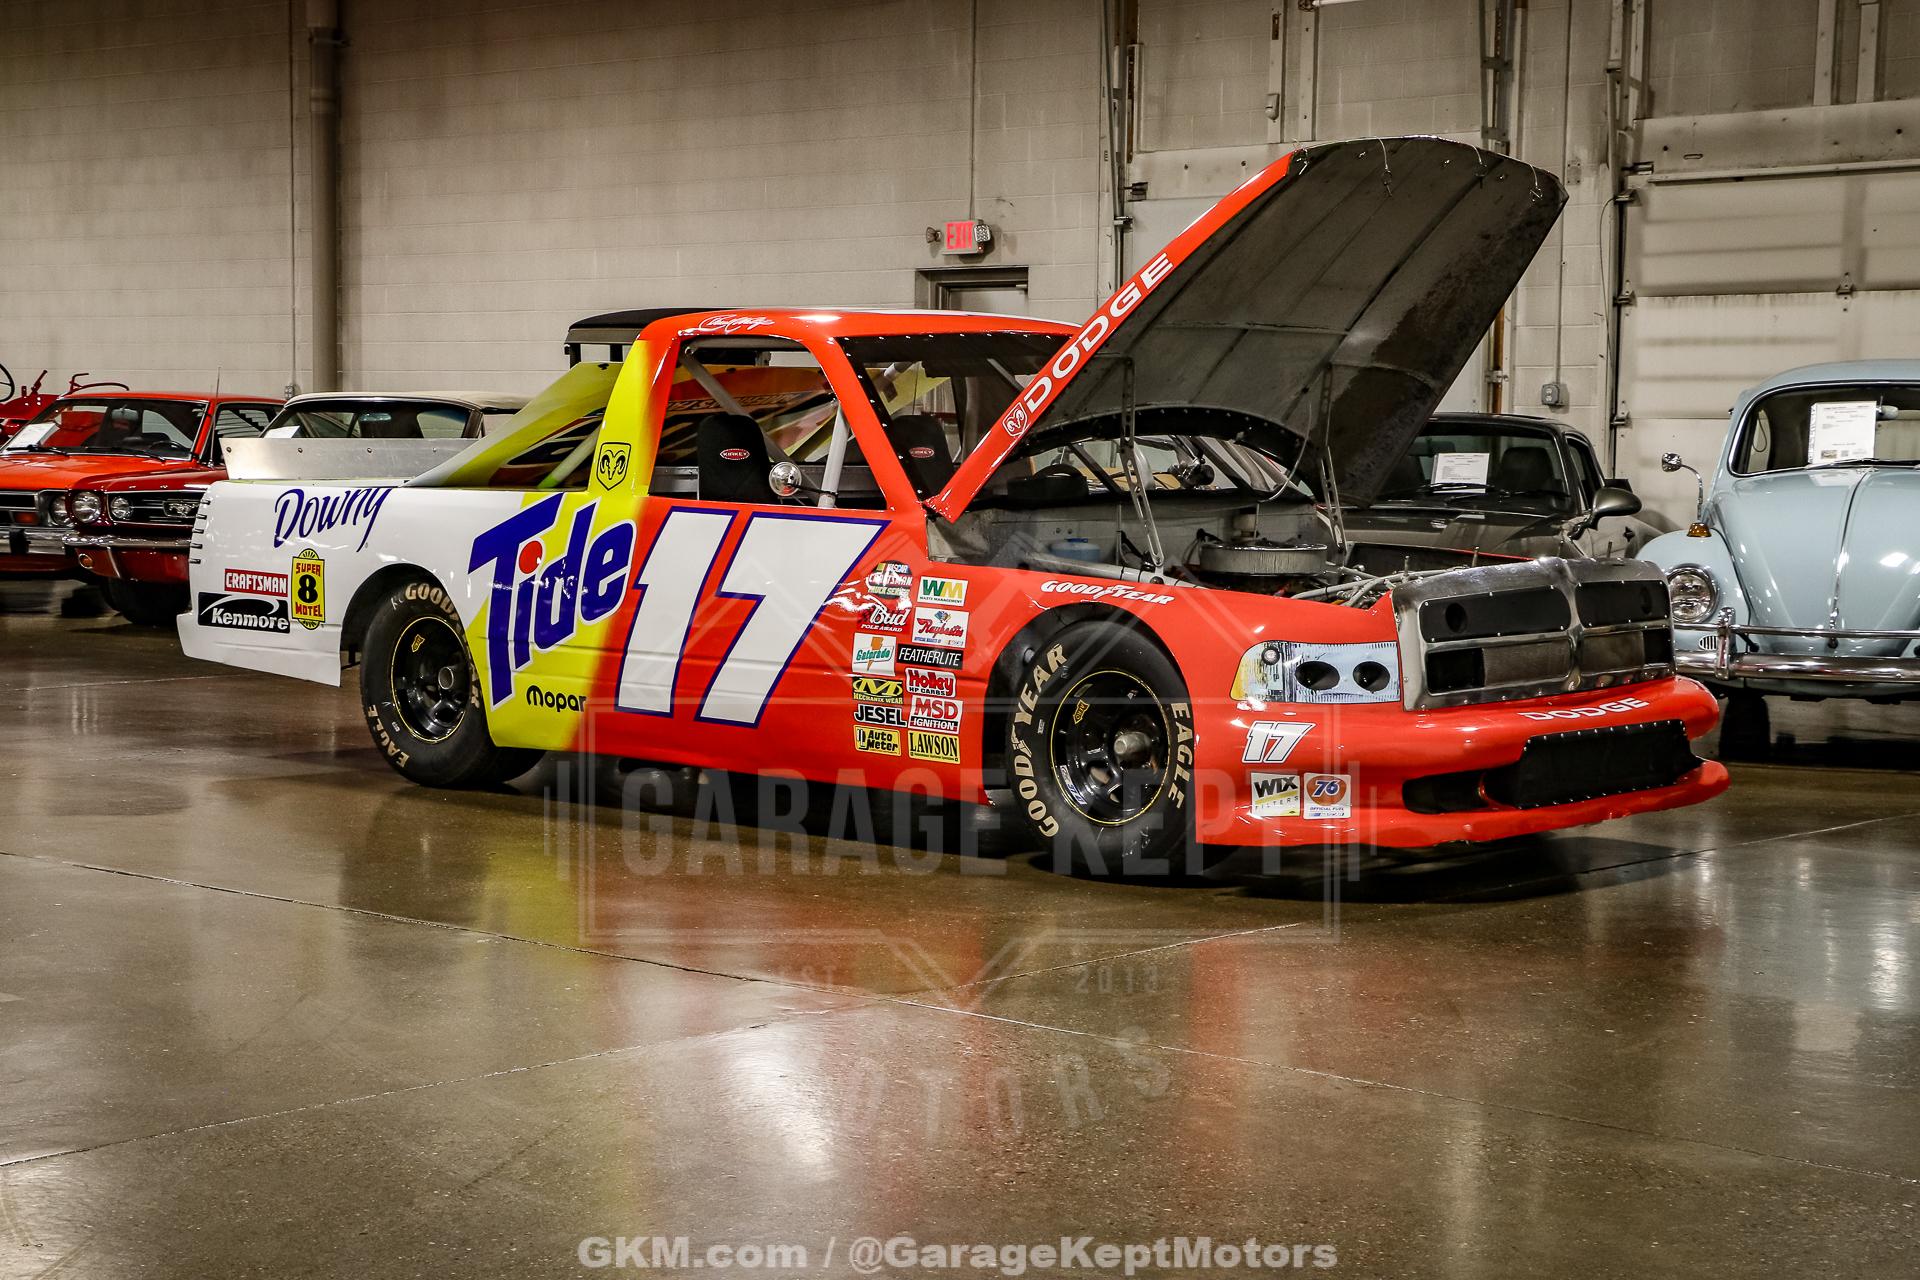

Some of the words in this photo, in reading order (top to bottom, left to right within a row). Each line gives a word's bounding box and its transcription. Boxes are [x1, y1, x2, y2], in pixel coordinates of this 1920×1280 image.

[946, 221, 975, 249] EXIT
[1023, 252, 1174, 413] DODGE
[274, 487, 393, 552] Downy
[295, 562, 321, 576] SUPER
[225, 572, 287, 594] CRAFTSMAN
[297, 574, 318, 603] 8
[923, 579, 963, 599] WM
[1041, 580, 1175, 605] GOODYEAR
[295, 603, 323, 617] MOTEL
[467, 491, 636, 709] Tide
[211, 607, 290, 630] Kenmore
[614, 506, 892, 729] 17
[870, 605, 910, 626] Bud
[898, 647, 961, 666] FEATHERLITE
[908, 669, 954, 696] Holley
[526, 685, 587, 713] Mopar
[853, 693, 884, 702] MECHANIX
[885, 696, 904, 704] WEAR
[914, 697, 958, 719] MSD
[1517, 697, 1650, 721] DODGE
[855, 705, 907, 726] JESEL
[913, 717, 954, 730] IGNITION
[367, 704, 410, 768] EAGLE
[866, 739, 898, 751] Meter
[868, 730, 892, 742] Auto
[910, 732, 958, 758] LAWSON
[1010, 643, 1068, 837] GOODYEAR
[1242, 720, 1317, 763] 17
[1167, 702, 1194, 809] EAGLE
[1254, 776, 1298, 798] WIX
[1312, 780, 1341, 797] 76
